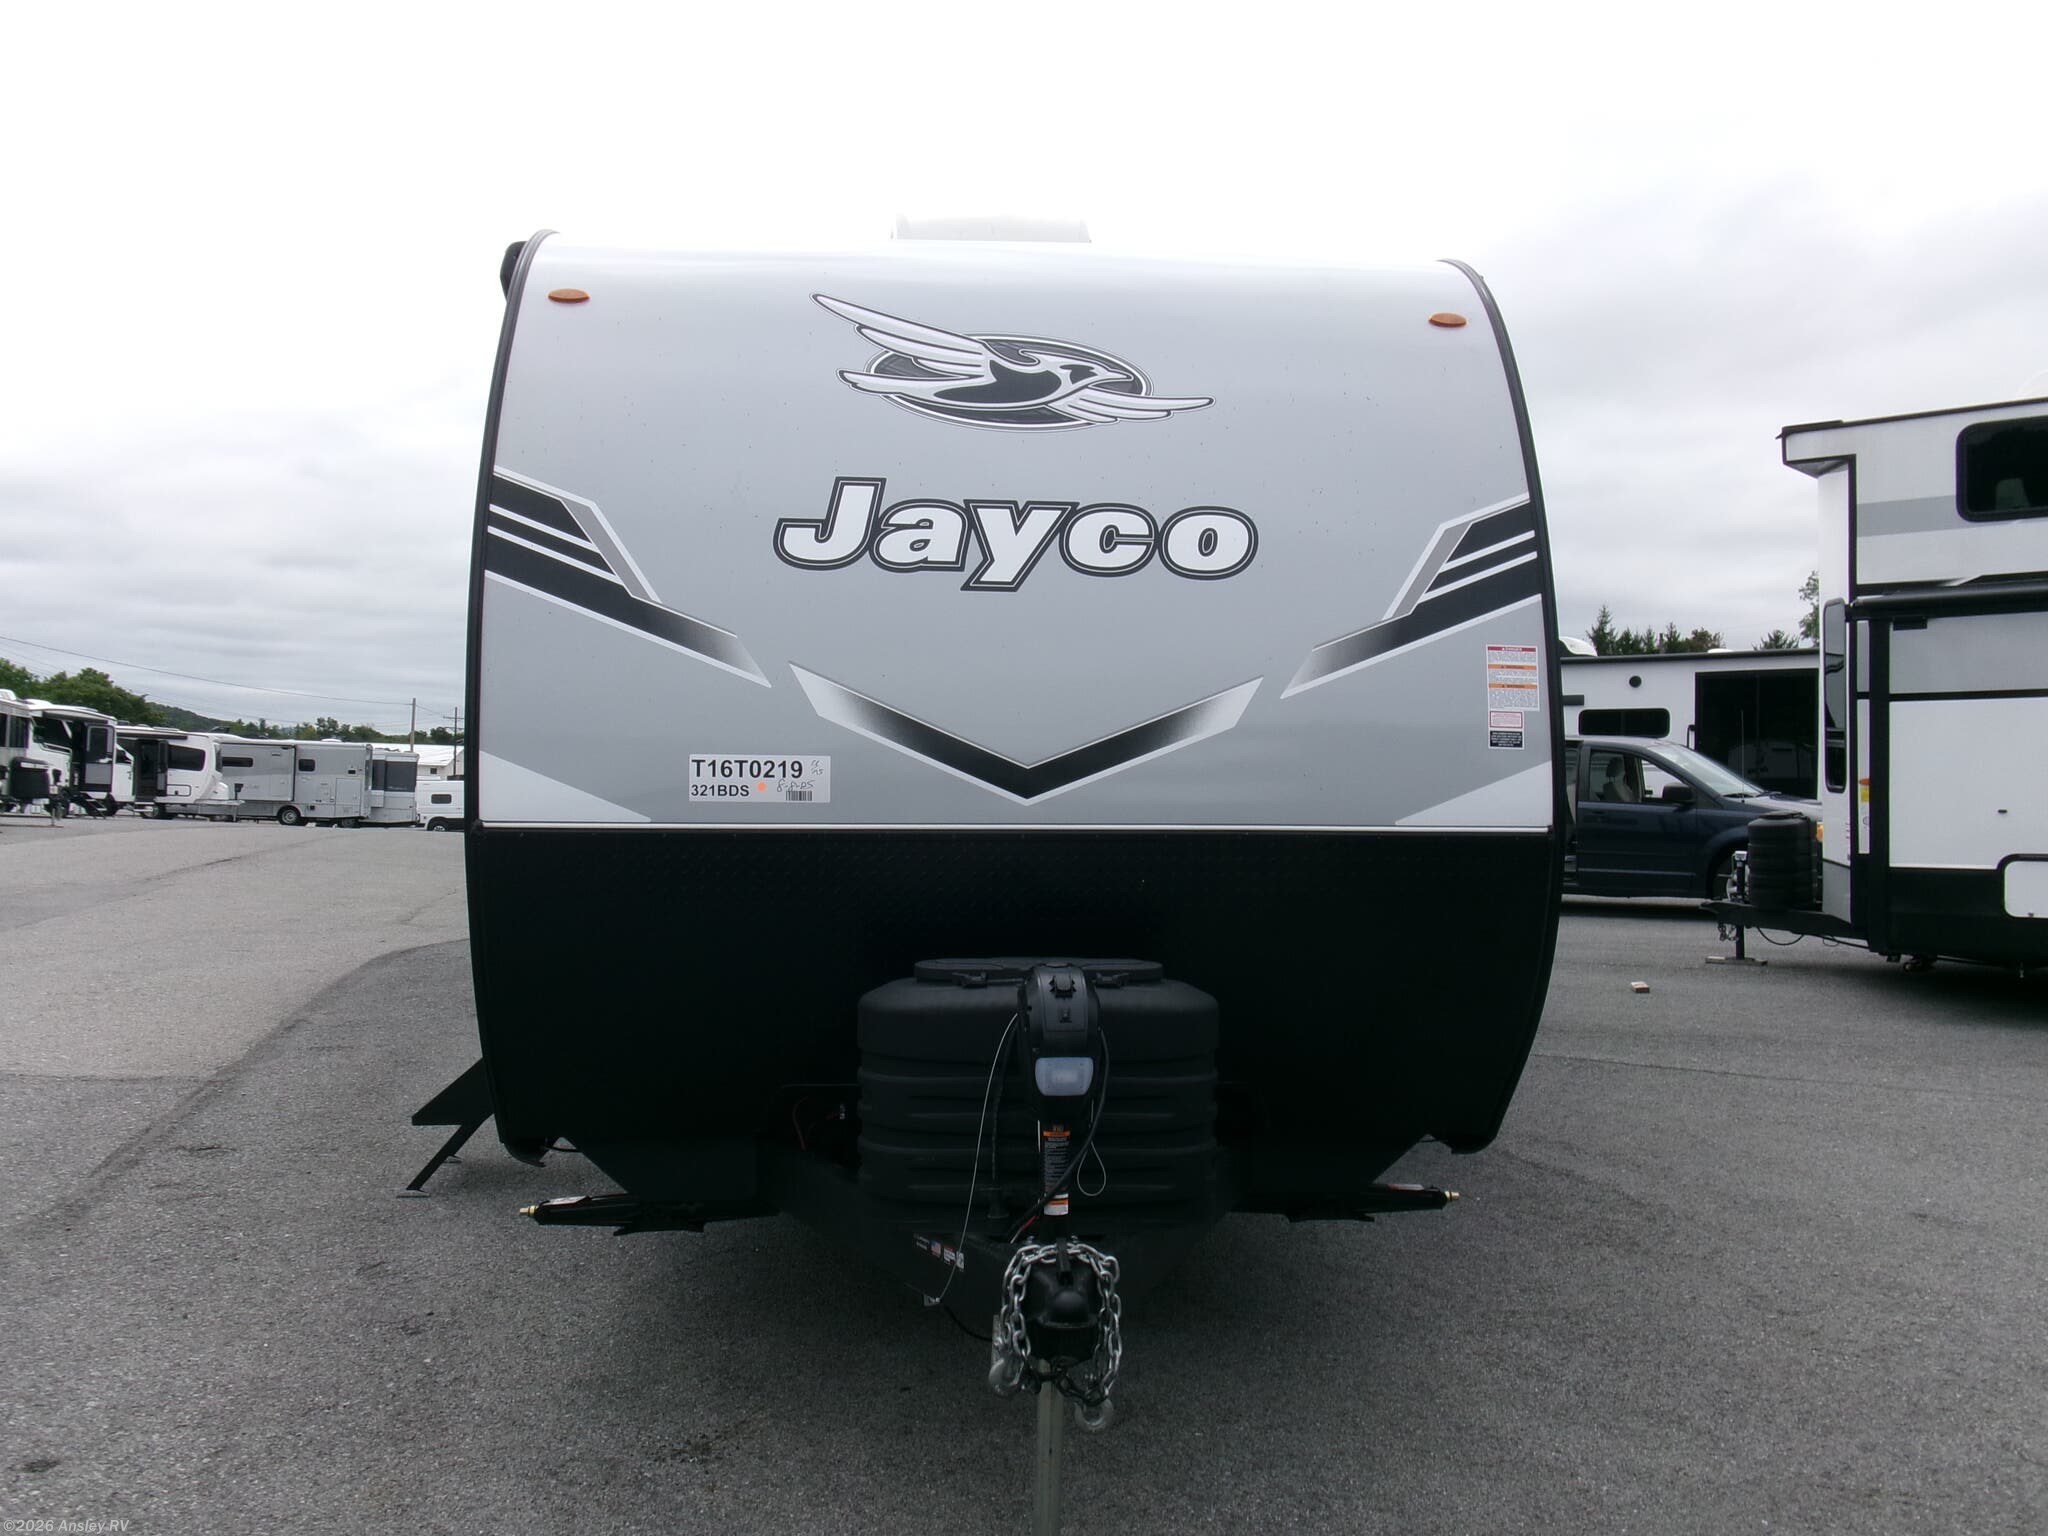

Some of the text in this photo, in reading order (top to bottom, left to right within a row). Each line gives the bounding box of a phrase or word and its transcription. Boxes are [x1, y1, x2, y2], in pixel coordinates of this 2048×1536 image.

[773, 476, 1259, 592] Jayco
[691, 759, 803, 779] T16T0219
[691, 784, 750, 797] 321BDS
